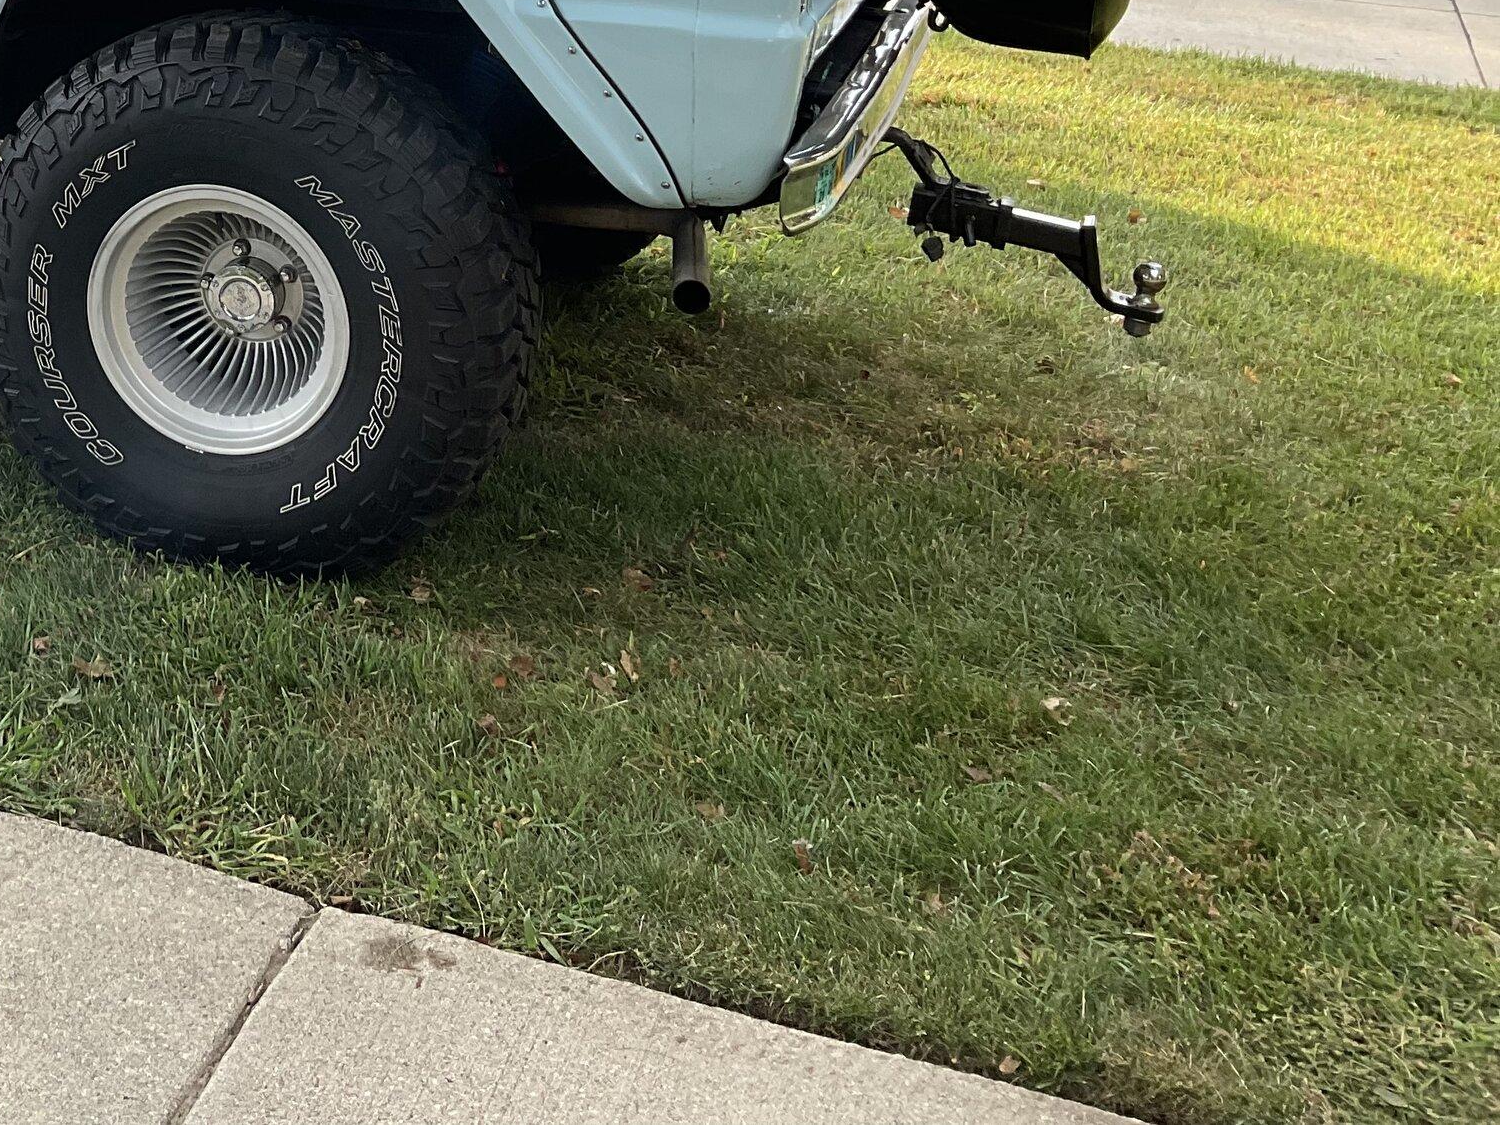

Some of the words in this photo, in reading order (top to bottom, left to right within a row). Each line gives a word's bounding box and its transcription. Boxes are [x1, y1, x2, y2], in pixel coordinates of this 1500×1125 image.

[51, 139, 136, 228] MXT
[25, 243, 125, 466] COURSER
[280, 175, 402, 513] MASTERCRAFT
